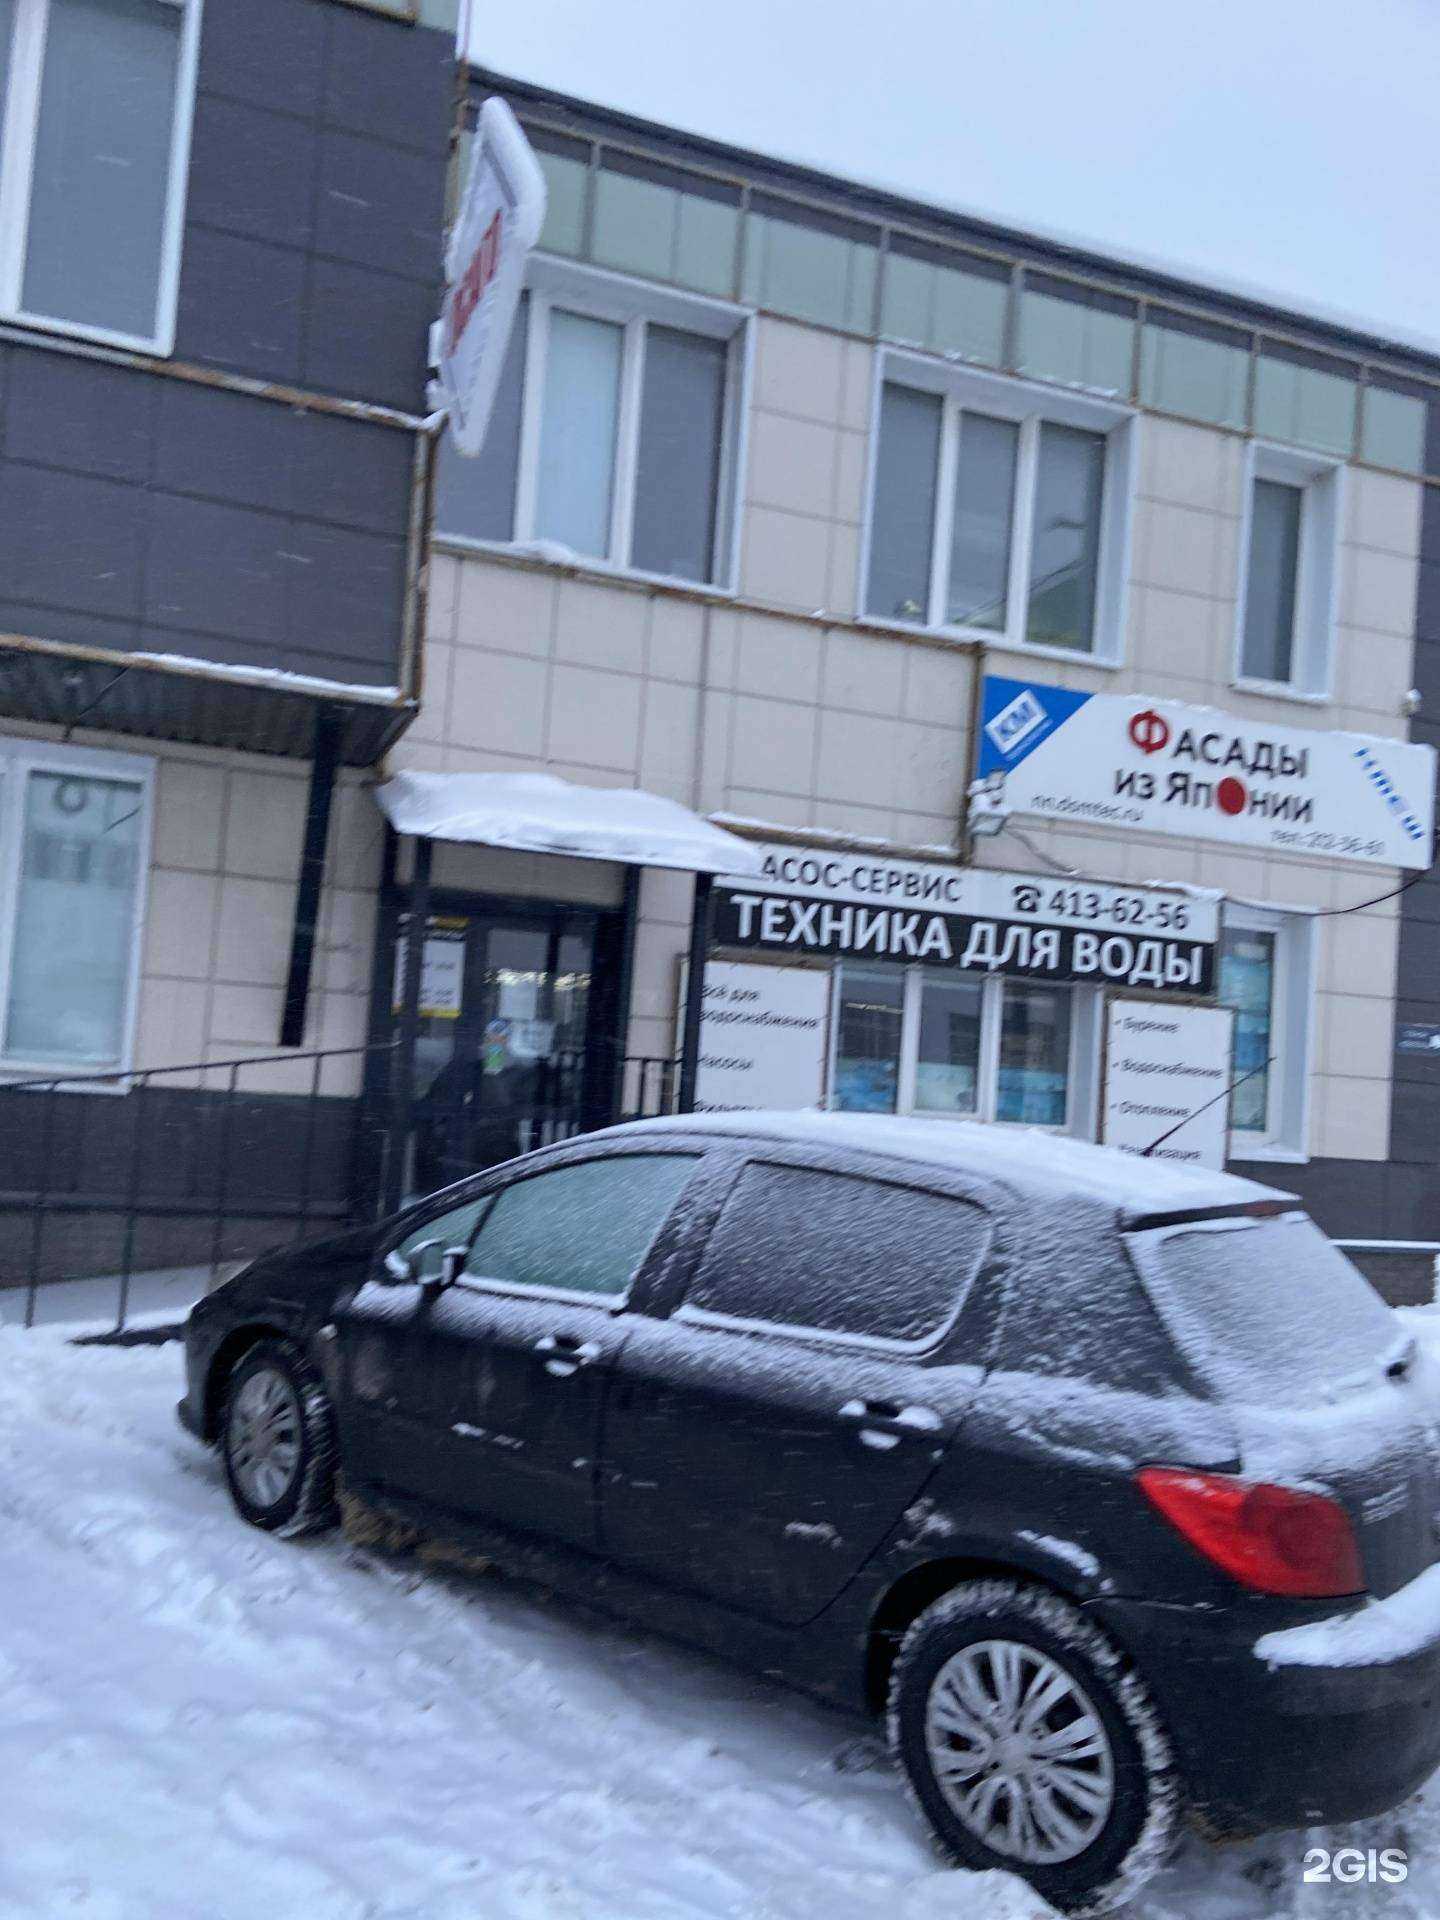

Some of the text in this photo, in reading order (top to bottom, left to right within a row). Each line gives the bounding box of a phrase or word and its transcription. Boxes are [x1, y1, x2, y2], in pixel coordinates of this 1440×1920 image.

[1128, 709, 1310, 779] ФАСАДЫ
[761, 855, 1188, 930] АСОС-СЕРВИС 413-62-56
[730, 893, 1204, 988] ТЕХНИКА ДЛЯ ВОДЫ
